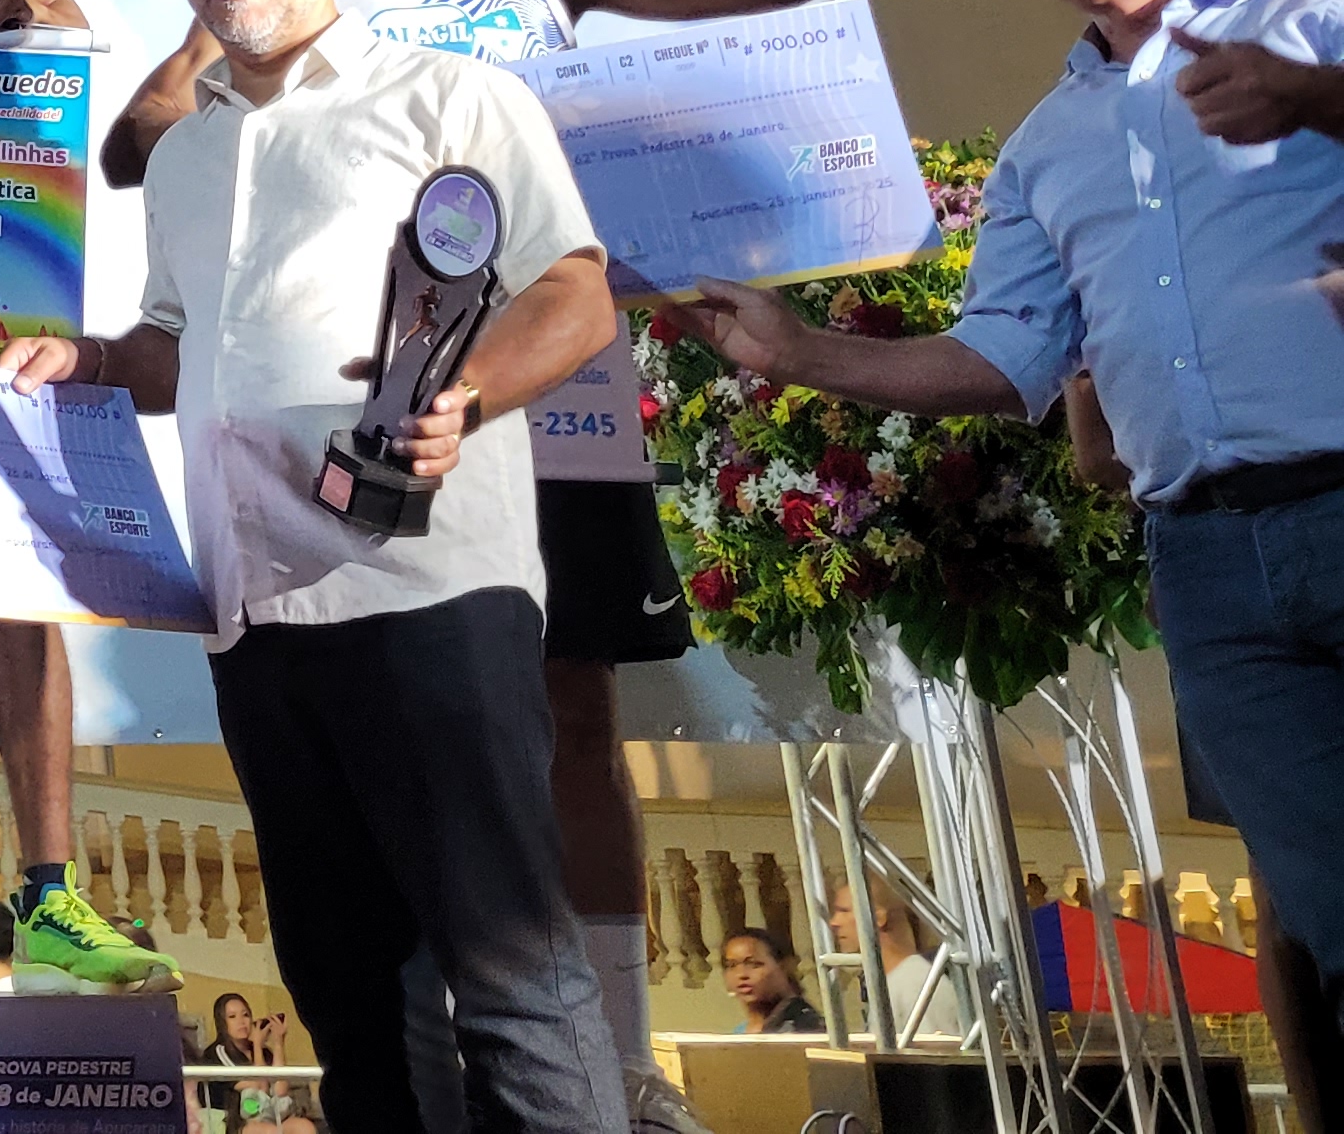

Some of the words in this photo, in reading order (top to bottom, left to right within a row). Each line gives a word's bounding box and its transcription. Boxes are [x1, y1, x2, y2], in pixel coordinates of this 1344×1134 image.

[556, 62, 590, 79] CONTA
[619, 55, 634, 68] C2
[654, 44, 694, 62] CHEQUE
[761, 29, 828, 53] 900,00
[719, 130, 733, 141] de
[737, 122, 785, 138] Janeiro
[819, 138, 859, 158] BANCO
[823, 151, 875, 172] ESPORTE
[104, 507, 135, 522] BANCO
[109, 521, 150, 537] ESPORTE
[45, 1060, 132, 1076] PEDESTRE
[15, 1088, 41, 1105] de
[44, 1084, 174, 1108] JANEIRO
